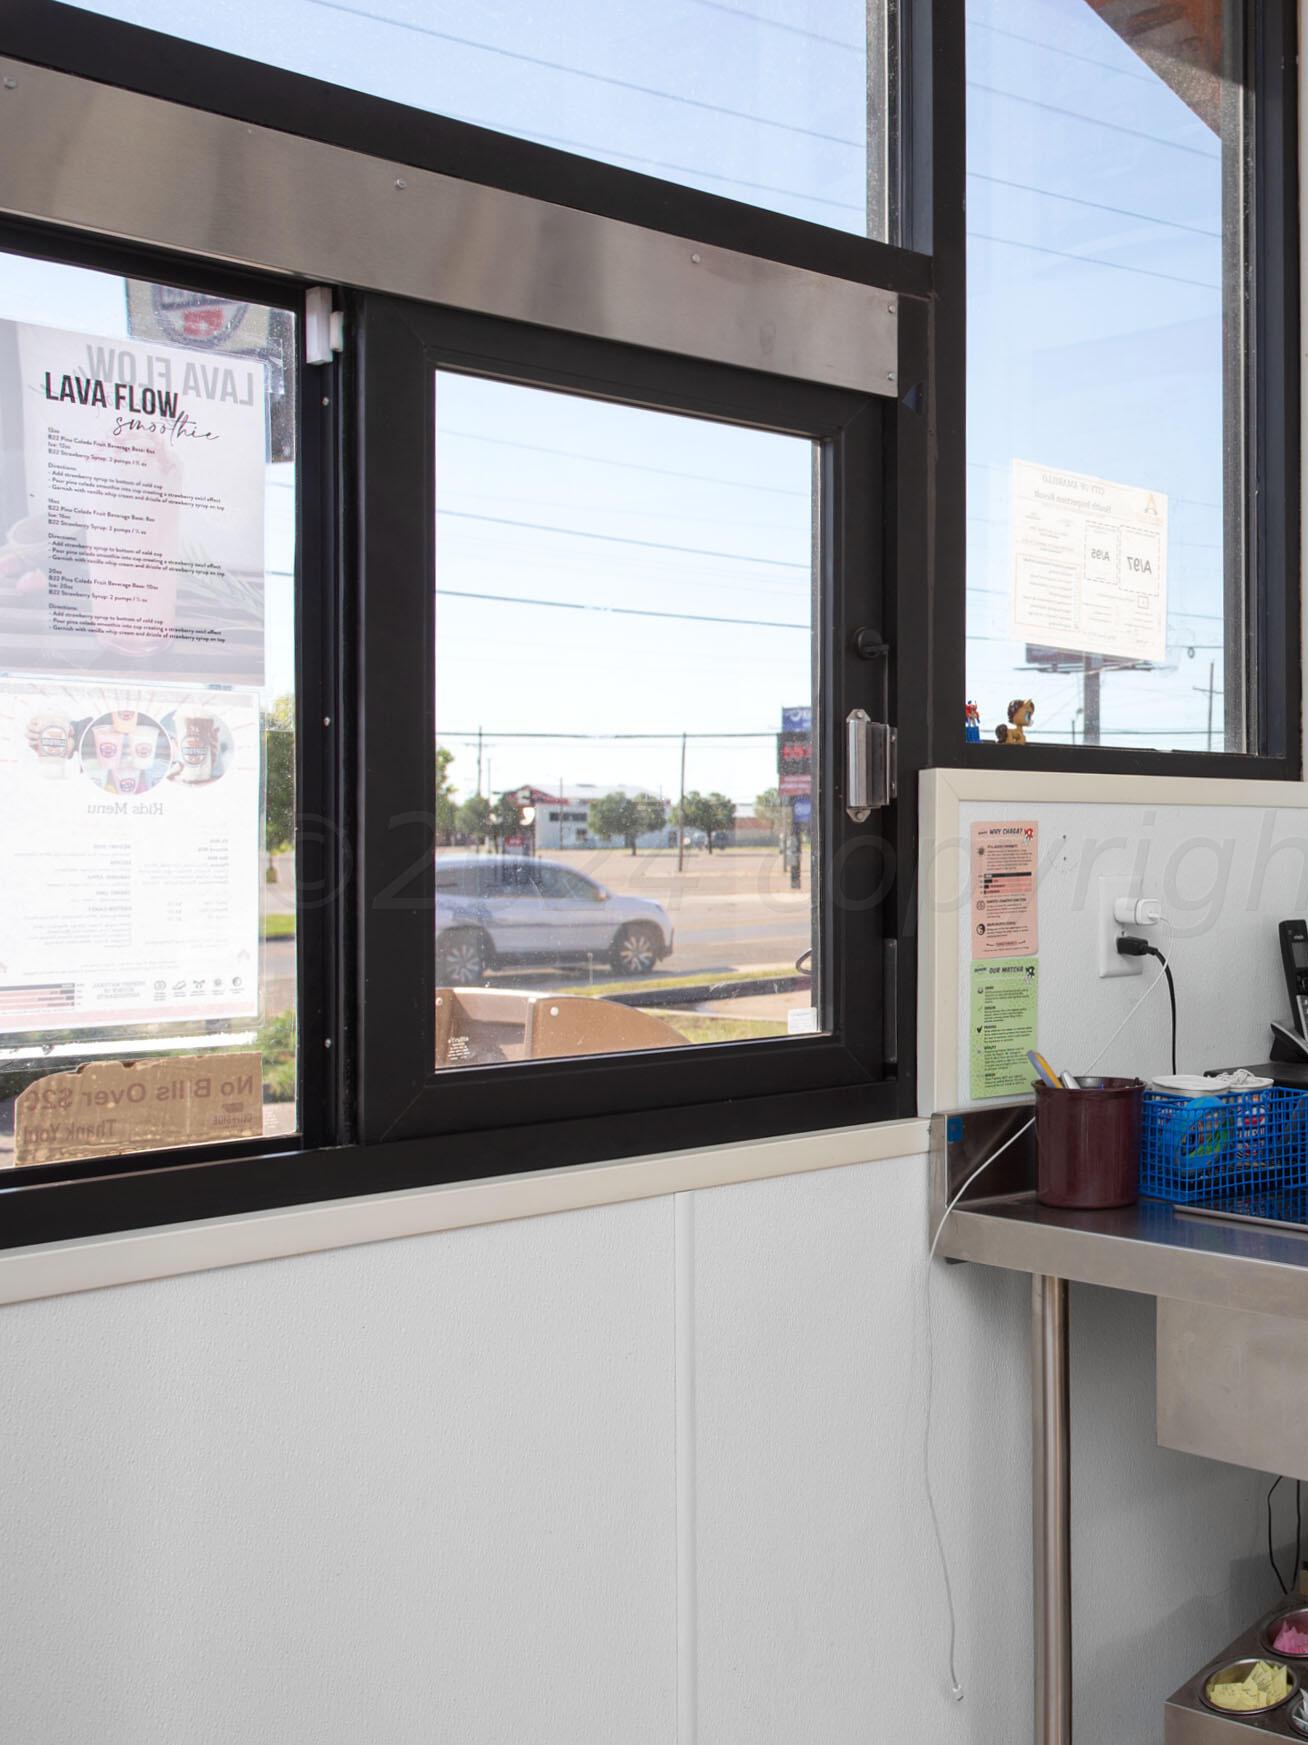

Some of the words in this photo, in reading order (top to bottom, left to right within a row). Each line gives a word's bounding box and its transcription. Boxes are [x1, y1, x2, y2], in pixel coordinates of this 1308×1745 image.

[45, 371, 107, 408] LAVA
[114, 383, 178, 418] FLOW
[112, 410, 220, 446] smoothie
